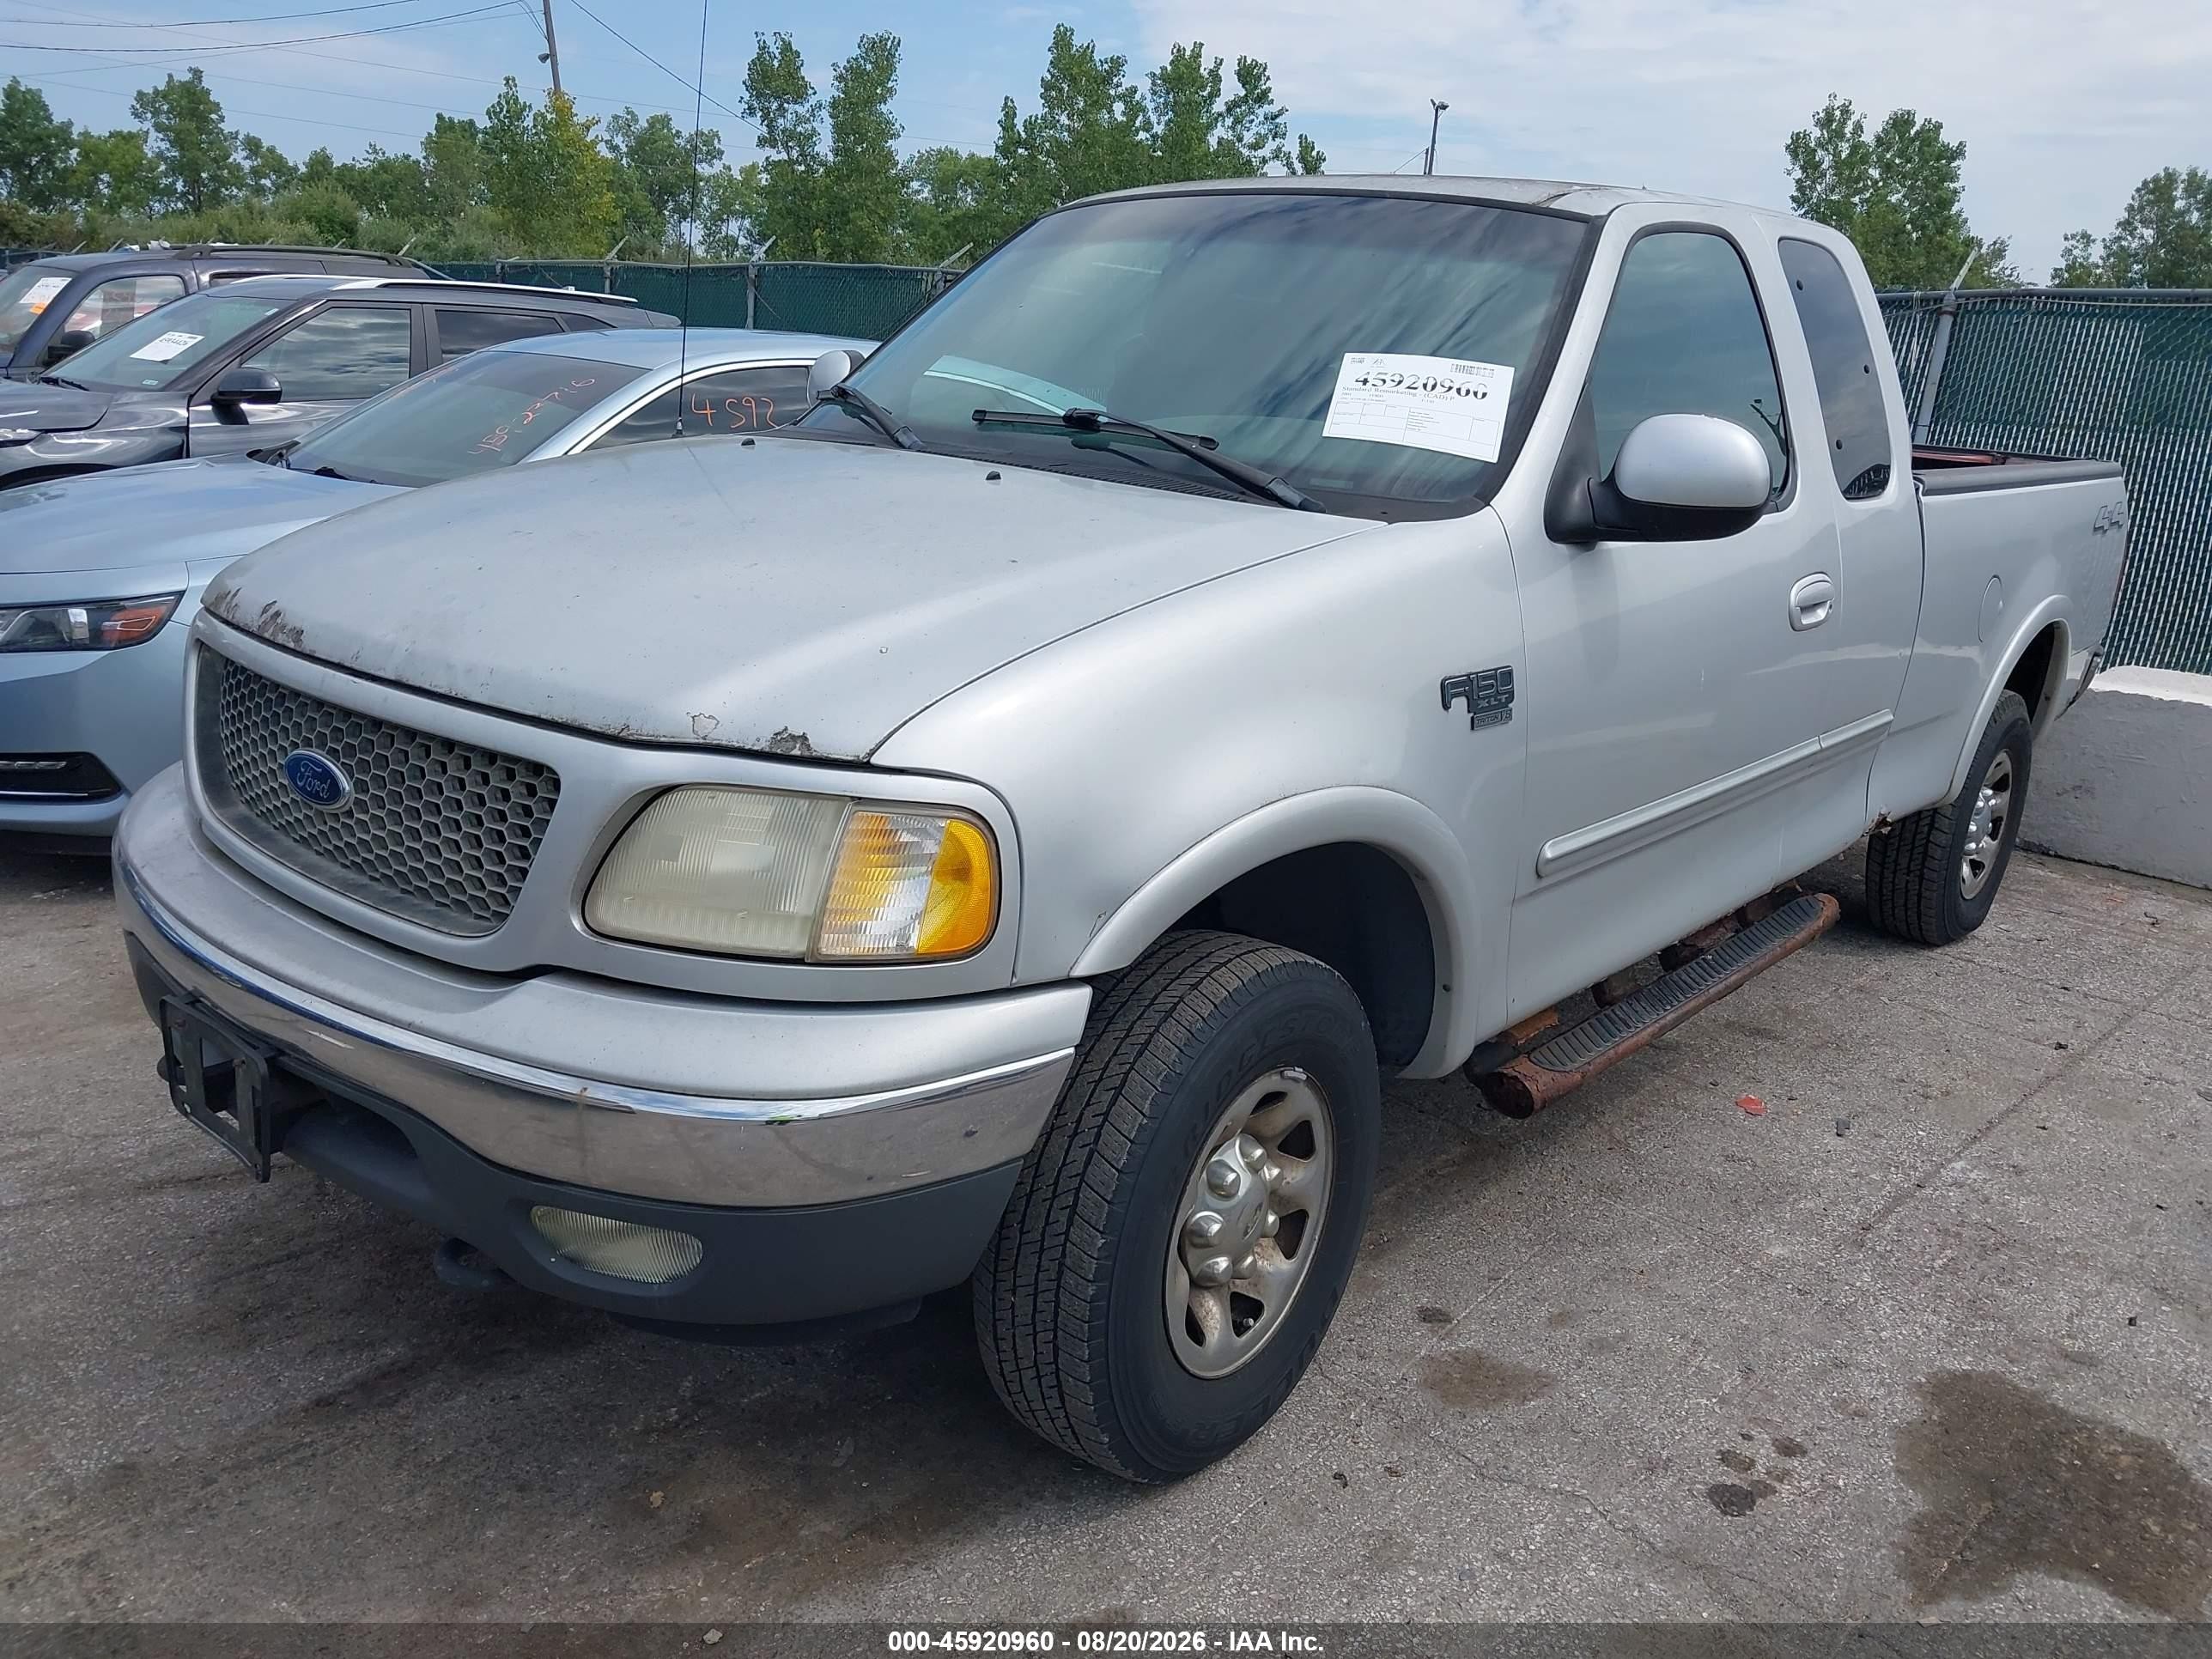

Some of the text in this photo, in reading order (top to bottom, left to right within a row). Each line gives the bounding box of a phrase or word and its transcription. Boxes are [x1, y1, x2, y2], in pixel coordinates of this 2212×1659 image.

[1354, 371, 1488, 400] 45920960
[1375, 386, 1417, 398] Remarketing
[1424, 392, 1449, 401] (CAD)
[1478, 694, 1510, 708] XLT
[1476, 708, 1512, 726] TRITON V8
[296, 760, 331, 799] Ford
